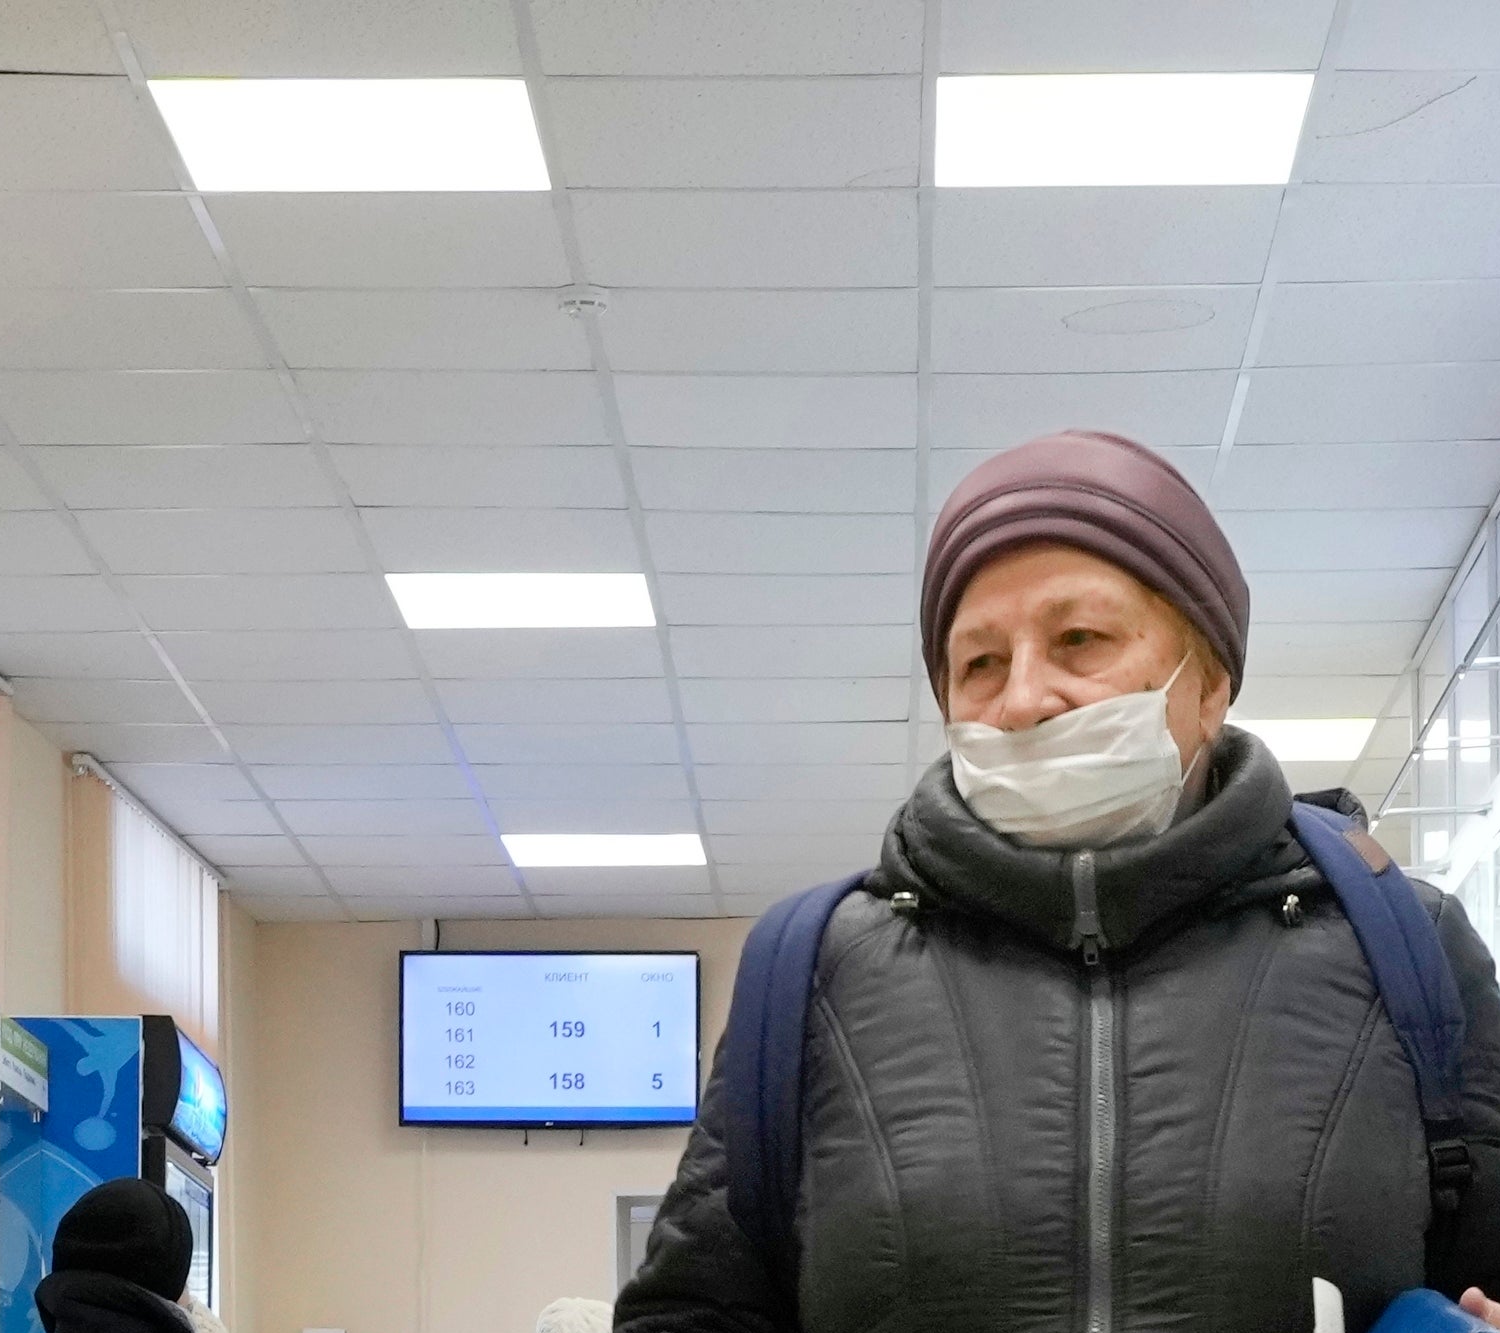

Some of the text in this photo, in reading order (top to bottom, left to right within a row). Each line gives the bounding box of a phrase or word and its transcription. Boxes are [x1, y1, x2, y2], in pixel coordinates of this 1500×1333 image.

[544, 972, 674, 983] КЛИЕНТ ОКНО
[445, 1001, 476, 1017] 160
[445, 1028, 474, 1043] 161
[549, 1020, 661, 1038] 159 1
[445, 1054, 476, 1069] 162
[445, 1081, 476, 1096] 163
[549, 1073, 663, 1090] 158 5
